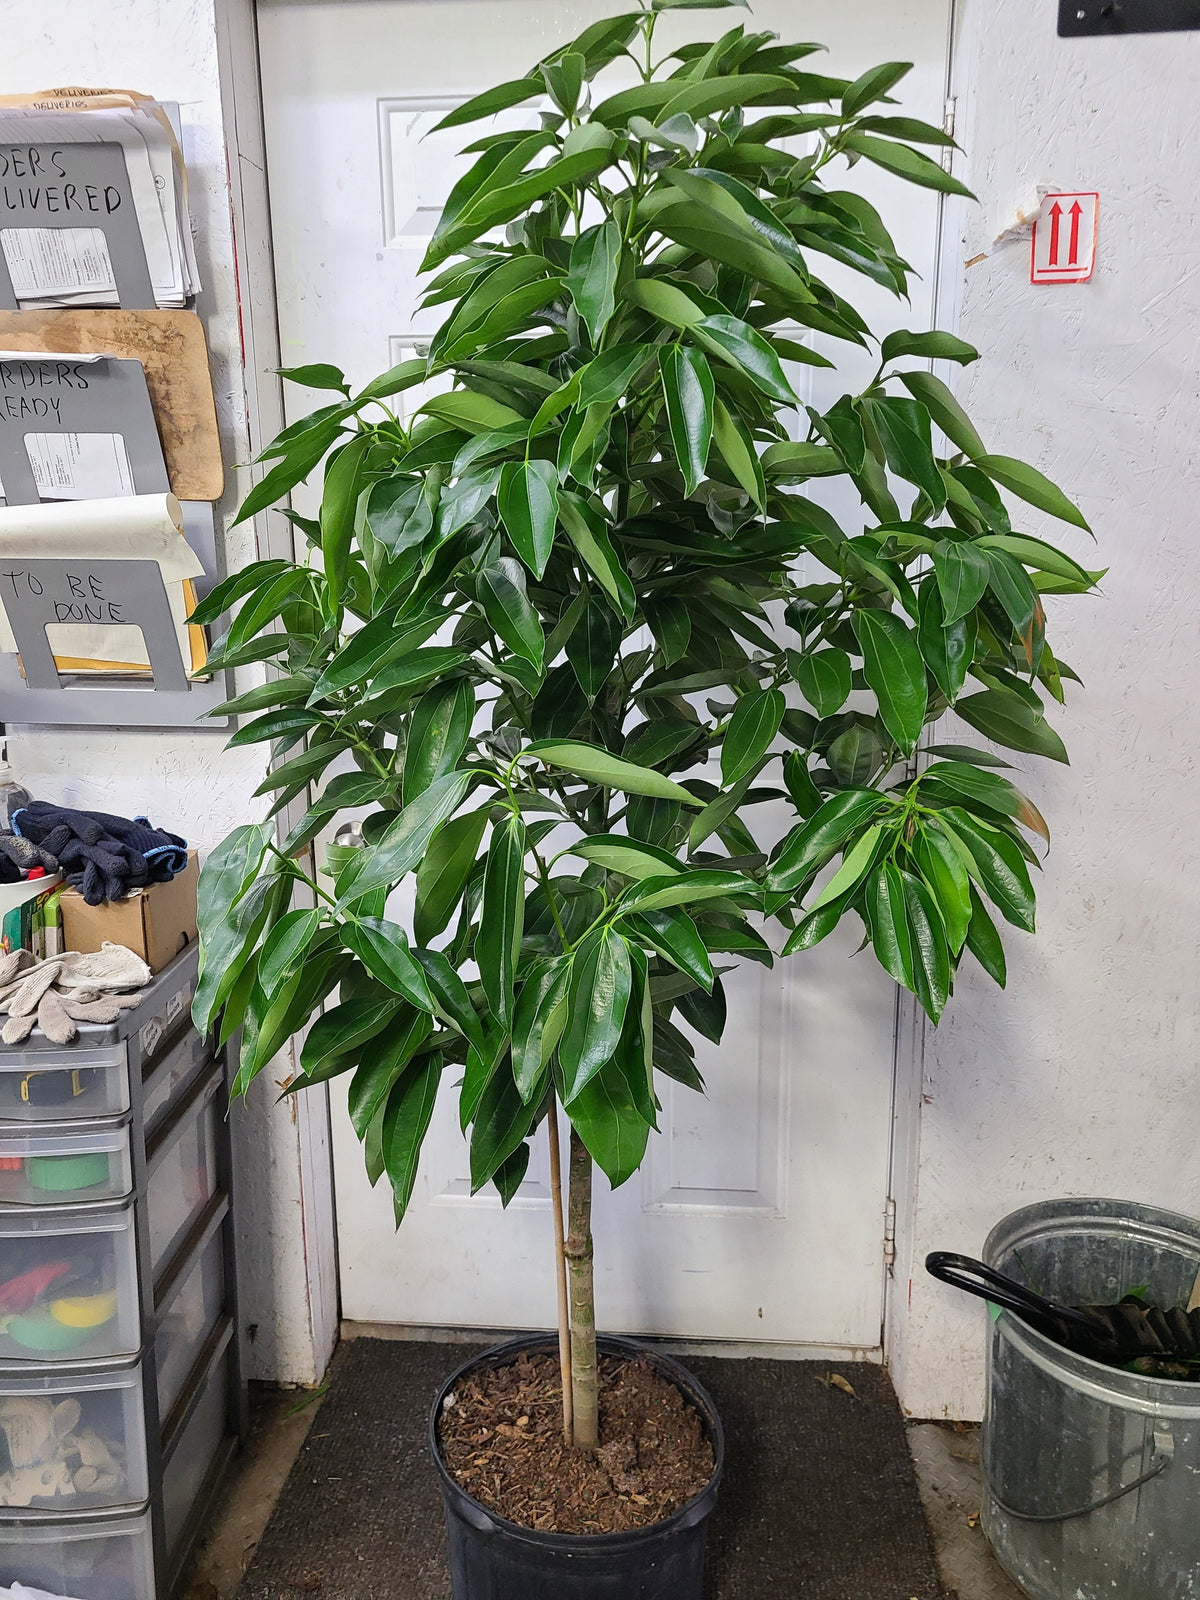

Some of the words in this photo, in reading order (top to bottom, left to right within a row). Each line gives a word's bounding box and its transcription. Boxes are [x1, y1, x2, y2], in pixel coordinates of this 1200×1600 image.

[33, 100, 88, 111] DELIVERIES
[4, 184, 121, 214] LIVERED
[0, 363, 89, 390] RDERS
[2, 571, 43, 599] TO
[66, 574, 105, 601] BE
[54, 600, 126, 623] DONE
